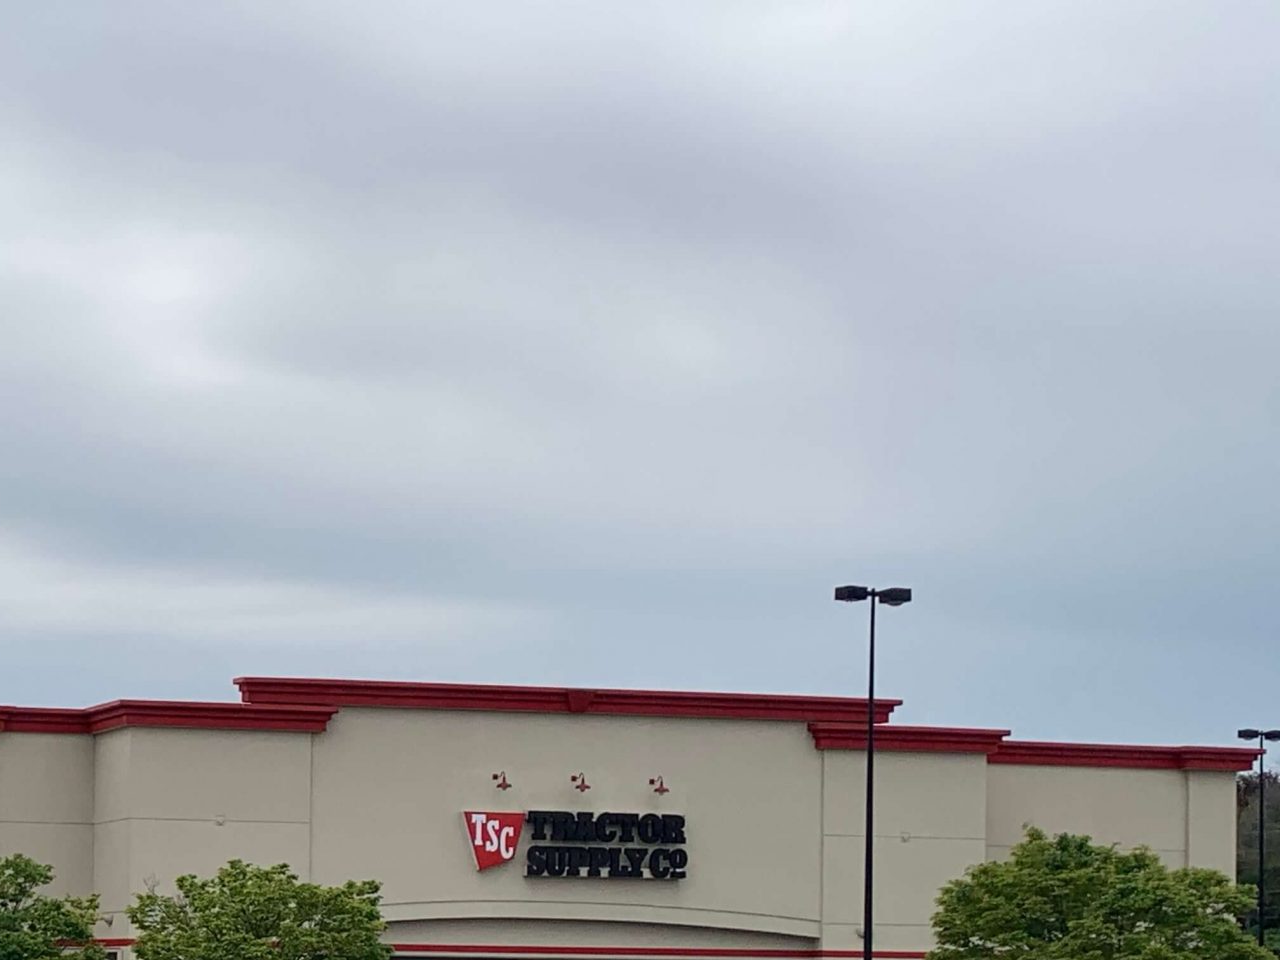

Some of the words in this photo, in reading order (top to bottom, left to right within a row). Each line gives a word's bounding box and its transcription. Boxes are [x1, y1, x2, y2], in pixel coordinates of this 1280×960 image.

[472, 814, 515, 859] TSC
[526, 811, 686, 844] TRACTOR
[526, 845, 649, 877] SUPPLY
